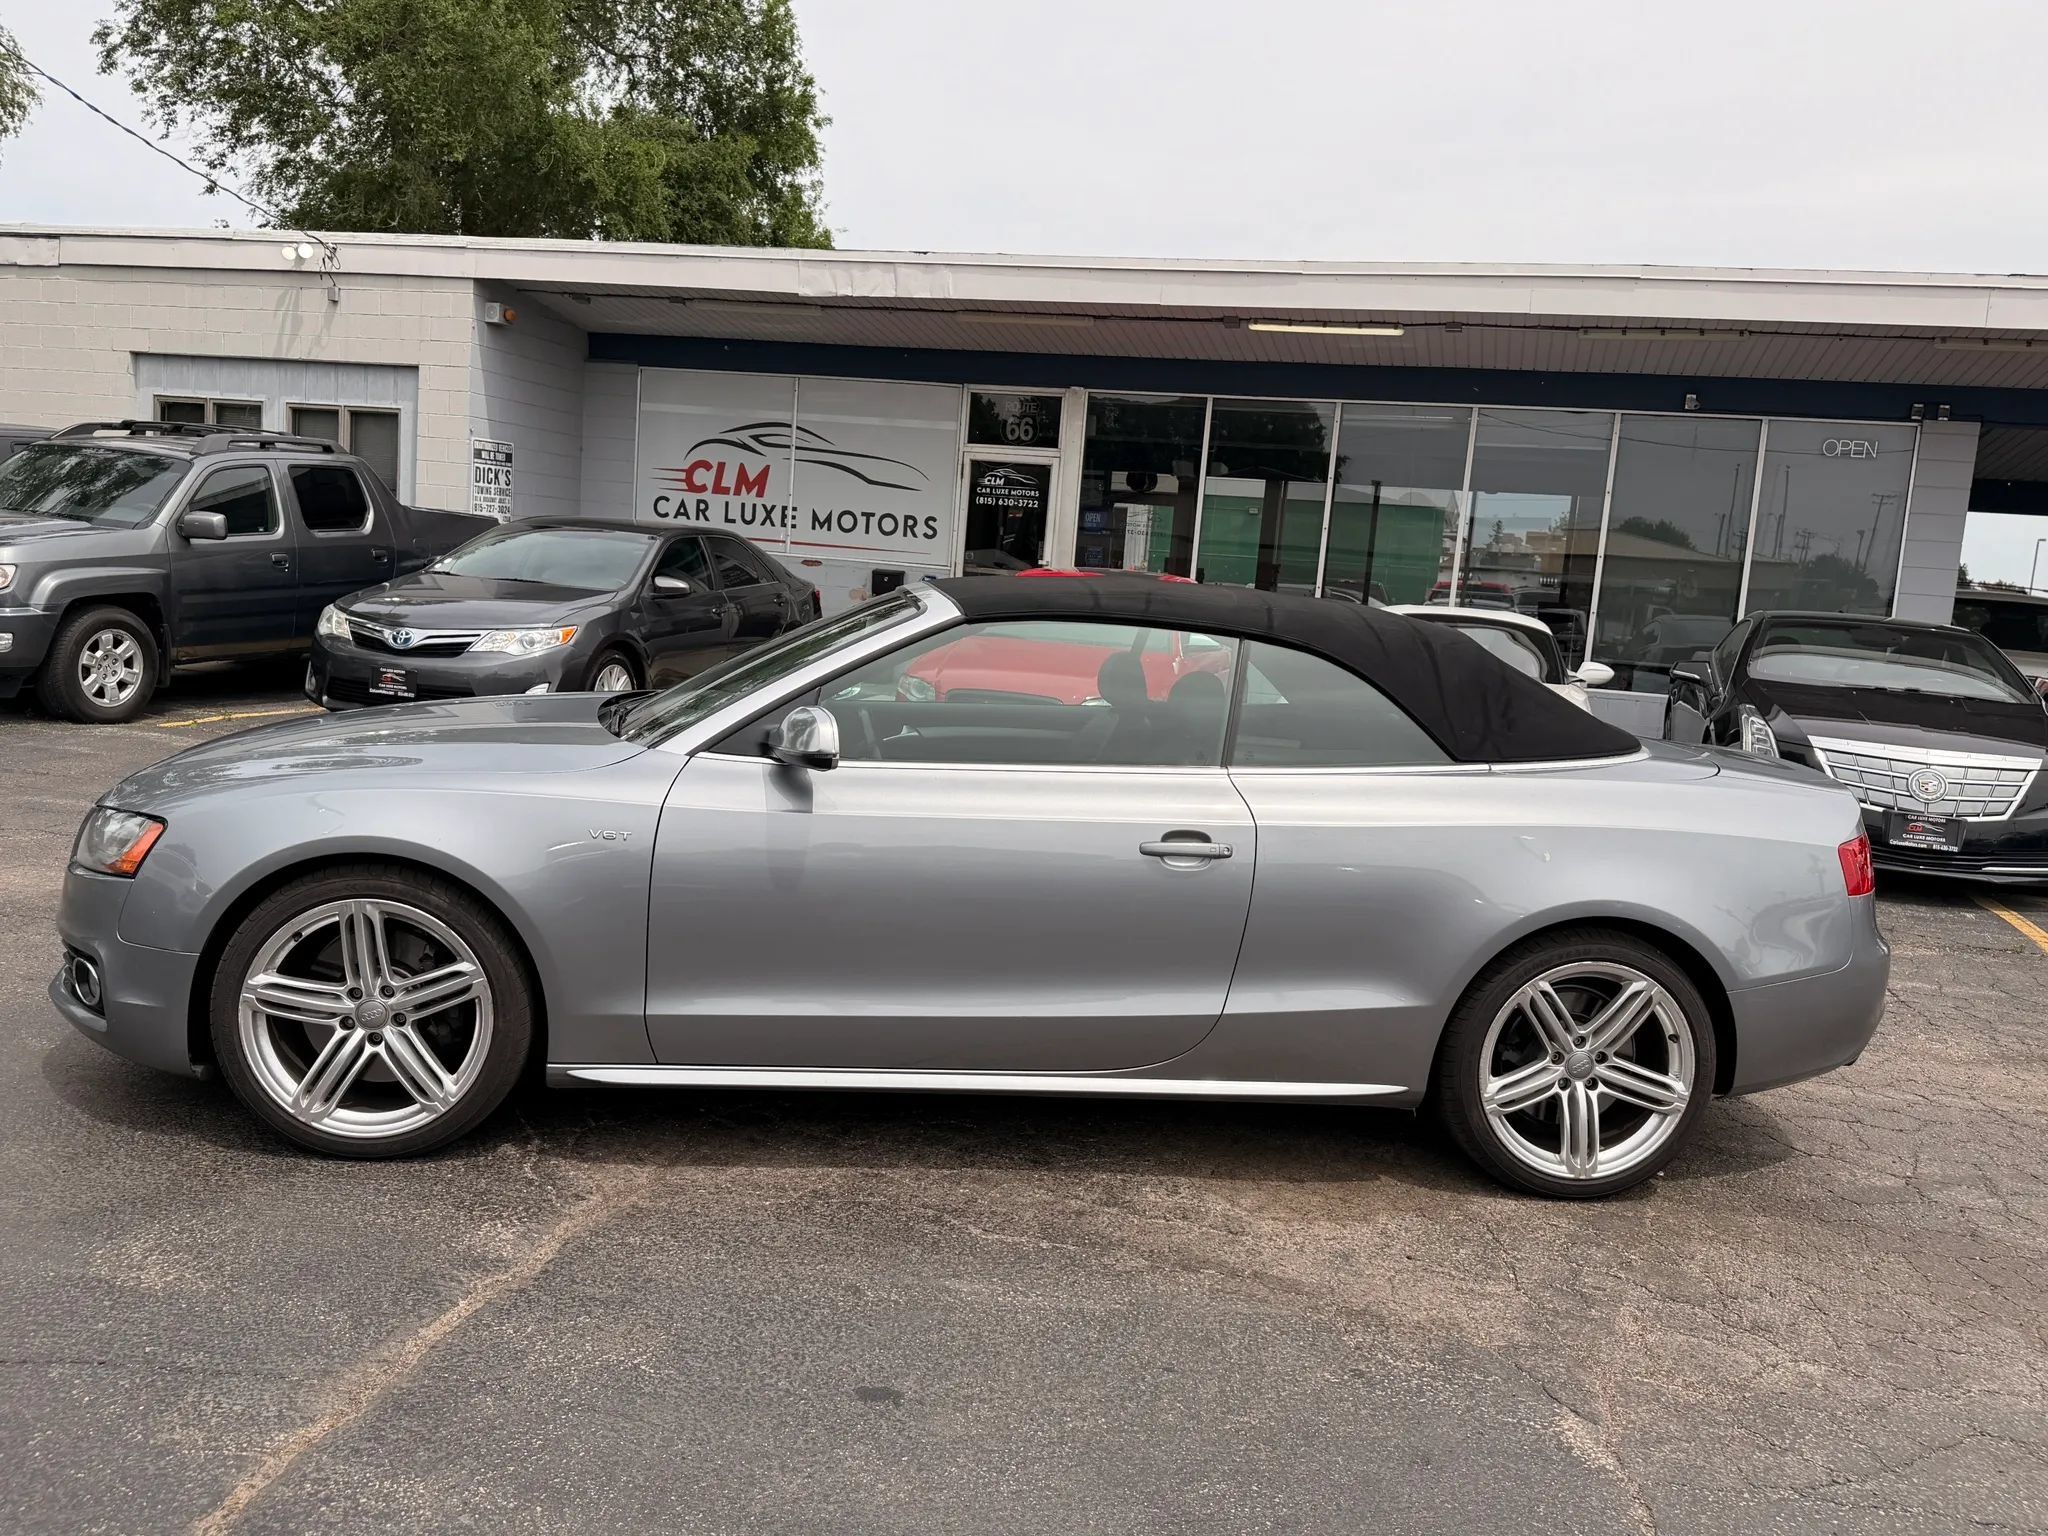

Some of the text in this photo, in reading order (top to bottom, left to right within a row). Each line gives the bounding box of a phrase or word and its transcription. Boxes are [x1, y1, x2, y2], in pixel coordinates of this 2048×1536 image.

[1005, 400, 1038, 413] ROUTE
[1005, 416, 1033, 441] 66
[1822, 438, 1878, 458] OPEN
[474, 466, 511, 487] DICK'S
[684, 459, 771, 498] CLM
[984, 476, 1005, 486] CLM
[474, 485, 512, 498] TOWING SERVICE
[992, 488, 1009, 496] LUXE
[1010, 489, 1040, 497] MOTORS
[975, 497, 1039, 508] (815) 630-3722
[653, 496, 938, 539] CAR LUXE MOTORS
[1085, 512, 1101, 522] OPEN
